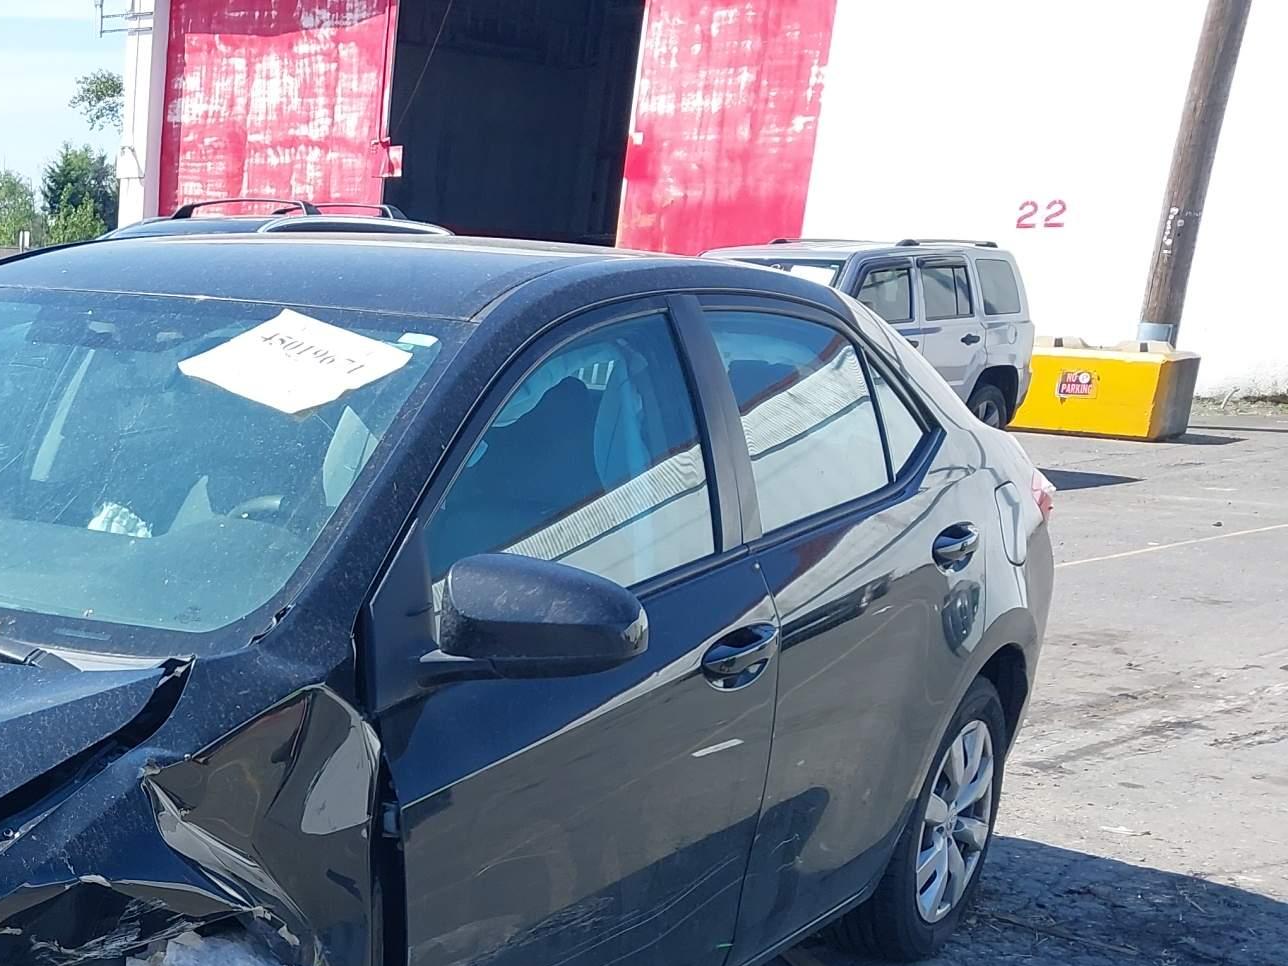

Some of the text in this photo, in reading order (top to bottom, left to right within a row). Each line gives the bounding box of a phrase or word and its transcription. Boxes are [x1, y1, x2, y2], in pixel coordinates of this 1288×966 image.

[1015, 199, 1066, 229] 22
[1066, 372, 1078, 383] NO
[1060, 383, 1093, 394] PARKING
